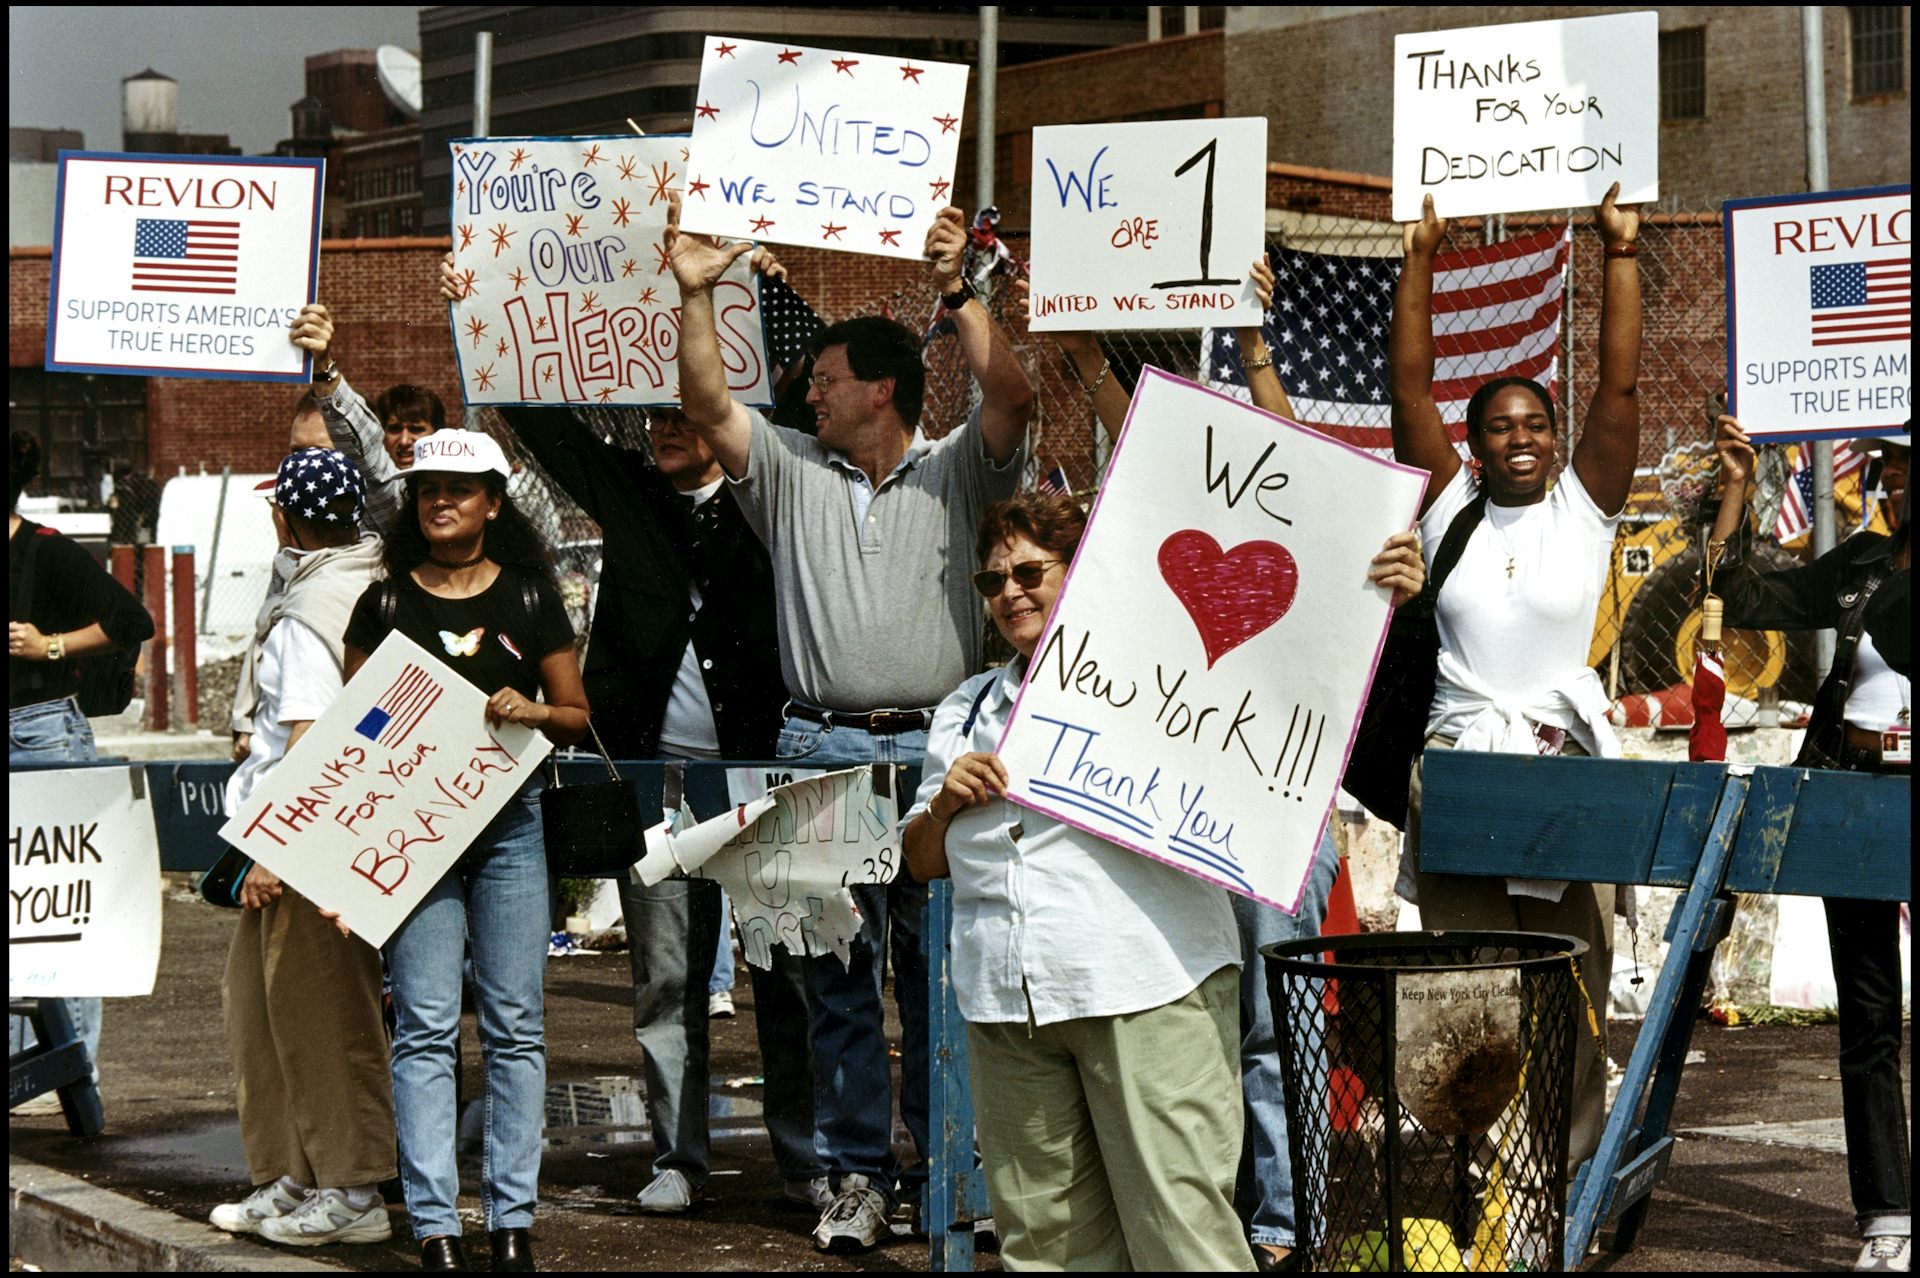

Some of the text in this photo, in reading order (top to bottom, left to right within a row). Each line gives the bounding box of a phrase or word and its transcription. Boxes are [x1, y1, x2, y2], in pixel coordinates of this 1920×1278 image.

[746, 79, 931, 167] UNITED
[1476, 93, 1603, 125] FOR YOUR
[105, 175, 277, 210] REVLON
[1046, 146, 1118, 213] WE
[1421, 143, 1623, 186] DEDICATION
[719, 176, 915, 219] WE STAND
[1151, 137, 1241, 289] 1
[530, 228, 626, 287] Our
[67, 299, 297, 329] SUPPORTS AMERICA'S
[1034, 293, 1235, 317] UNITED WE STAND
[107, 329, 255, 356] TRUE HEROES
[504, 281, 761, 402] HEROS
[1746, 356, 1867, 386] SUPPORTS
[1790, 386, 1911, 414] TRUE HER
[1206, 425, 1292, 527] We
[1030, 624, 1137, 710] New
[243, 745, 366, 846] THANKS
[335, 743, 437, 836] FOR YOUR
[1031, 714, 1162, 821] Thank
[350, 731, 519, 896] BRAVERY
[1402, 987, 1425, 1004] Keep
[1427, 988, 1447, 1001] New
[1450, 987, 1471, 1001] York
